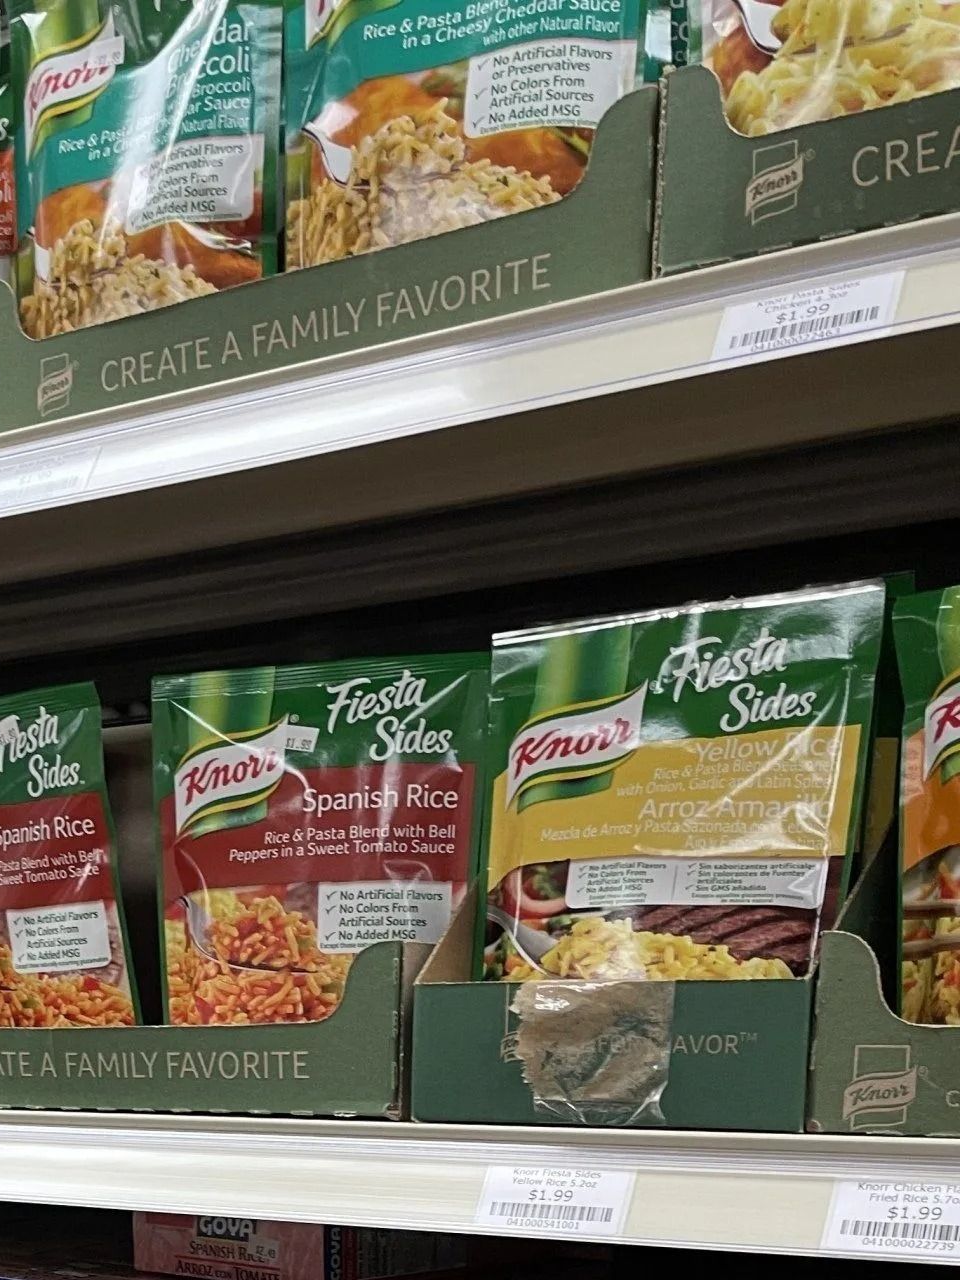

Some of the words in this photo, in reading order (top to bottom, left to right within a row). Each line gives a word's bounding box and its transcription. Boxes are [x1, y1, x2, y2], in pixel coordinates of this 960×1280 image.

[493, 55, 509, 67] No
[511, 45, 566, 64] Artificial
[569, 45, 613, 61] Flavors
[492, 69, 505, 80] or
[506, 61, 590, 79] Preservatives
[491, 83, 507, 97] No
[510, 79, 551, 94] Colors
[553, 76, 585, 90] From
[490, 92, 543, 109] Artificial
[546, 89, 595, 103] Sources
[489, 110, 505, 124] No
[508, 106, 550, 123] Added
[552, 105, 581, 118] MSG
[100, 337, 212, 392] CREATE
[222, 331, 242, 364] A
[252, 298, 368, 358] FAMILY
[376, 253, 552, 328] FAVORITE
[776, 303, 830, 324] $1.99
[327, 669, 427, 734] Fiesta
[720, 682, 817, 733] Sides
[369, 716, 453, 762] Sides
[513, 718, 633, 780] Knorr
[302, 785, 399, 817] Spanish
[406, 783, 458, 808] Rice
[54, 816, 96, 839] Rice
[264, 831, 291, 845] Rice
[292, 830, 304, 842] &
[306, 828, 345, 842] Pasta
[349, 826, 389, 840] Blend
[393, 825, 425, 837] with
[428, 825, 456, 838] Bell
[229, 848, 278, 864] Peppers
[281, 846, 293, 857] in
[295, 847, 304, 856] a
[307, 842, 350, 856] Sweet
[354, 841, 407, 853] Tomato
[411, 841, 455, 854] Sauce
[340, 891, 354, 900] No
[357, 889, 403, 900] Artificial
[406, 889, 444, 901] Flavors
[339, 904, 353, 913] No
[356, 903, 390, 913] Colors
[392, 903, 418, 913] From
[339, 916, 385, 928] Artificial
[386, 917, 427, 928] Sources
[339, 930, 352, 940] No
[356, 929, 389, 940] Added
[391, 930, 416, 940] MSG
[40, 1052, 58, 1079] A
[65, 1051, 161, 1080] FAMILY
[167, 1050, 310, 1080] FAVORITE
[529, 1189, 574, 1202] $1.99
[858, 1182, 889, 1192] Knorr
[893, 1182, 941, 1193] Chicken
[869, 1193, 899, 1202] Fried
[903, 1193, 929, 1203] Rice
[887, 1206, 943, 1221] $1.99
